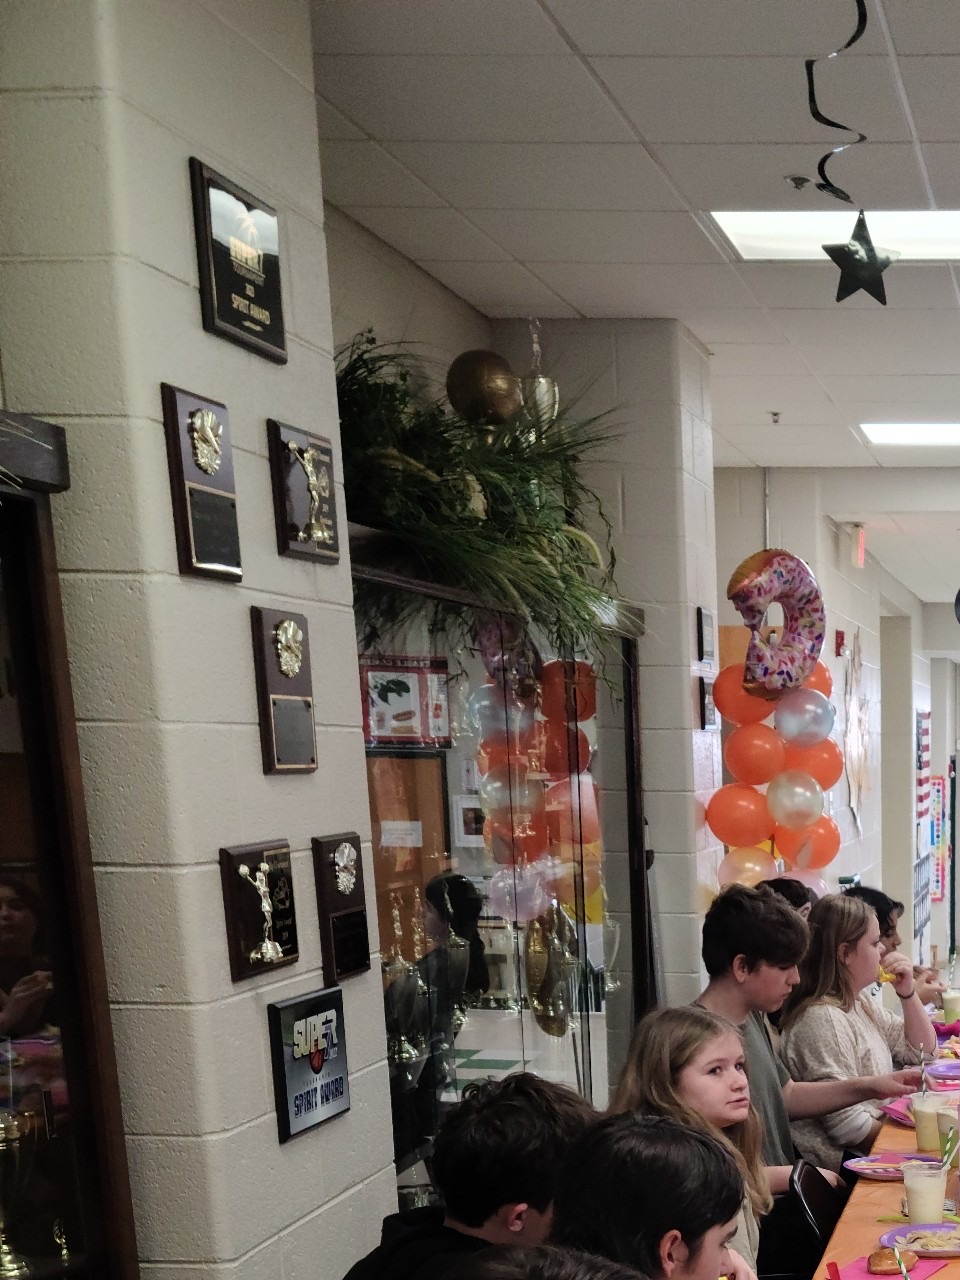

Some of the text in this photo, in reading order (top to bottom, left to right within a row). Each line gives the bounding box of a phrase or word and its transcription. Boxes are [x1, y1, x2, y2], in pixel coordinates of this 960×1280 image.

[293, 1009, 338, 1059] SUPER
[294, 1076, 344, 1118] SPIRIT AWARD
